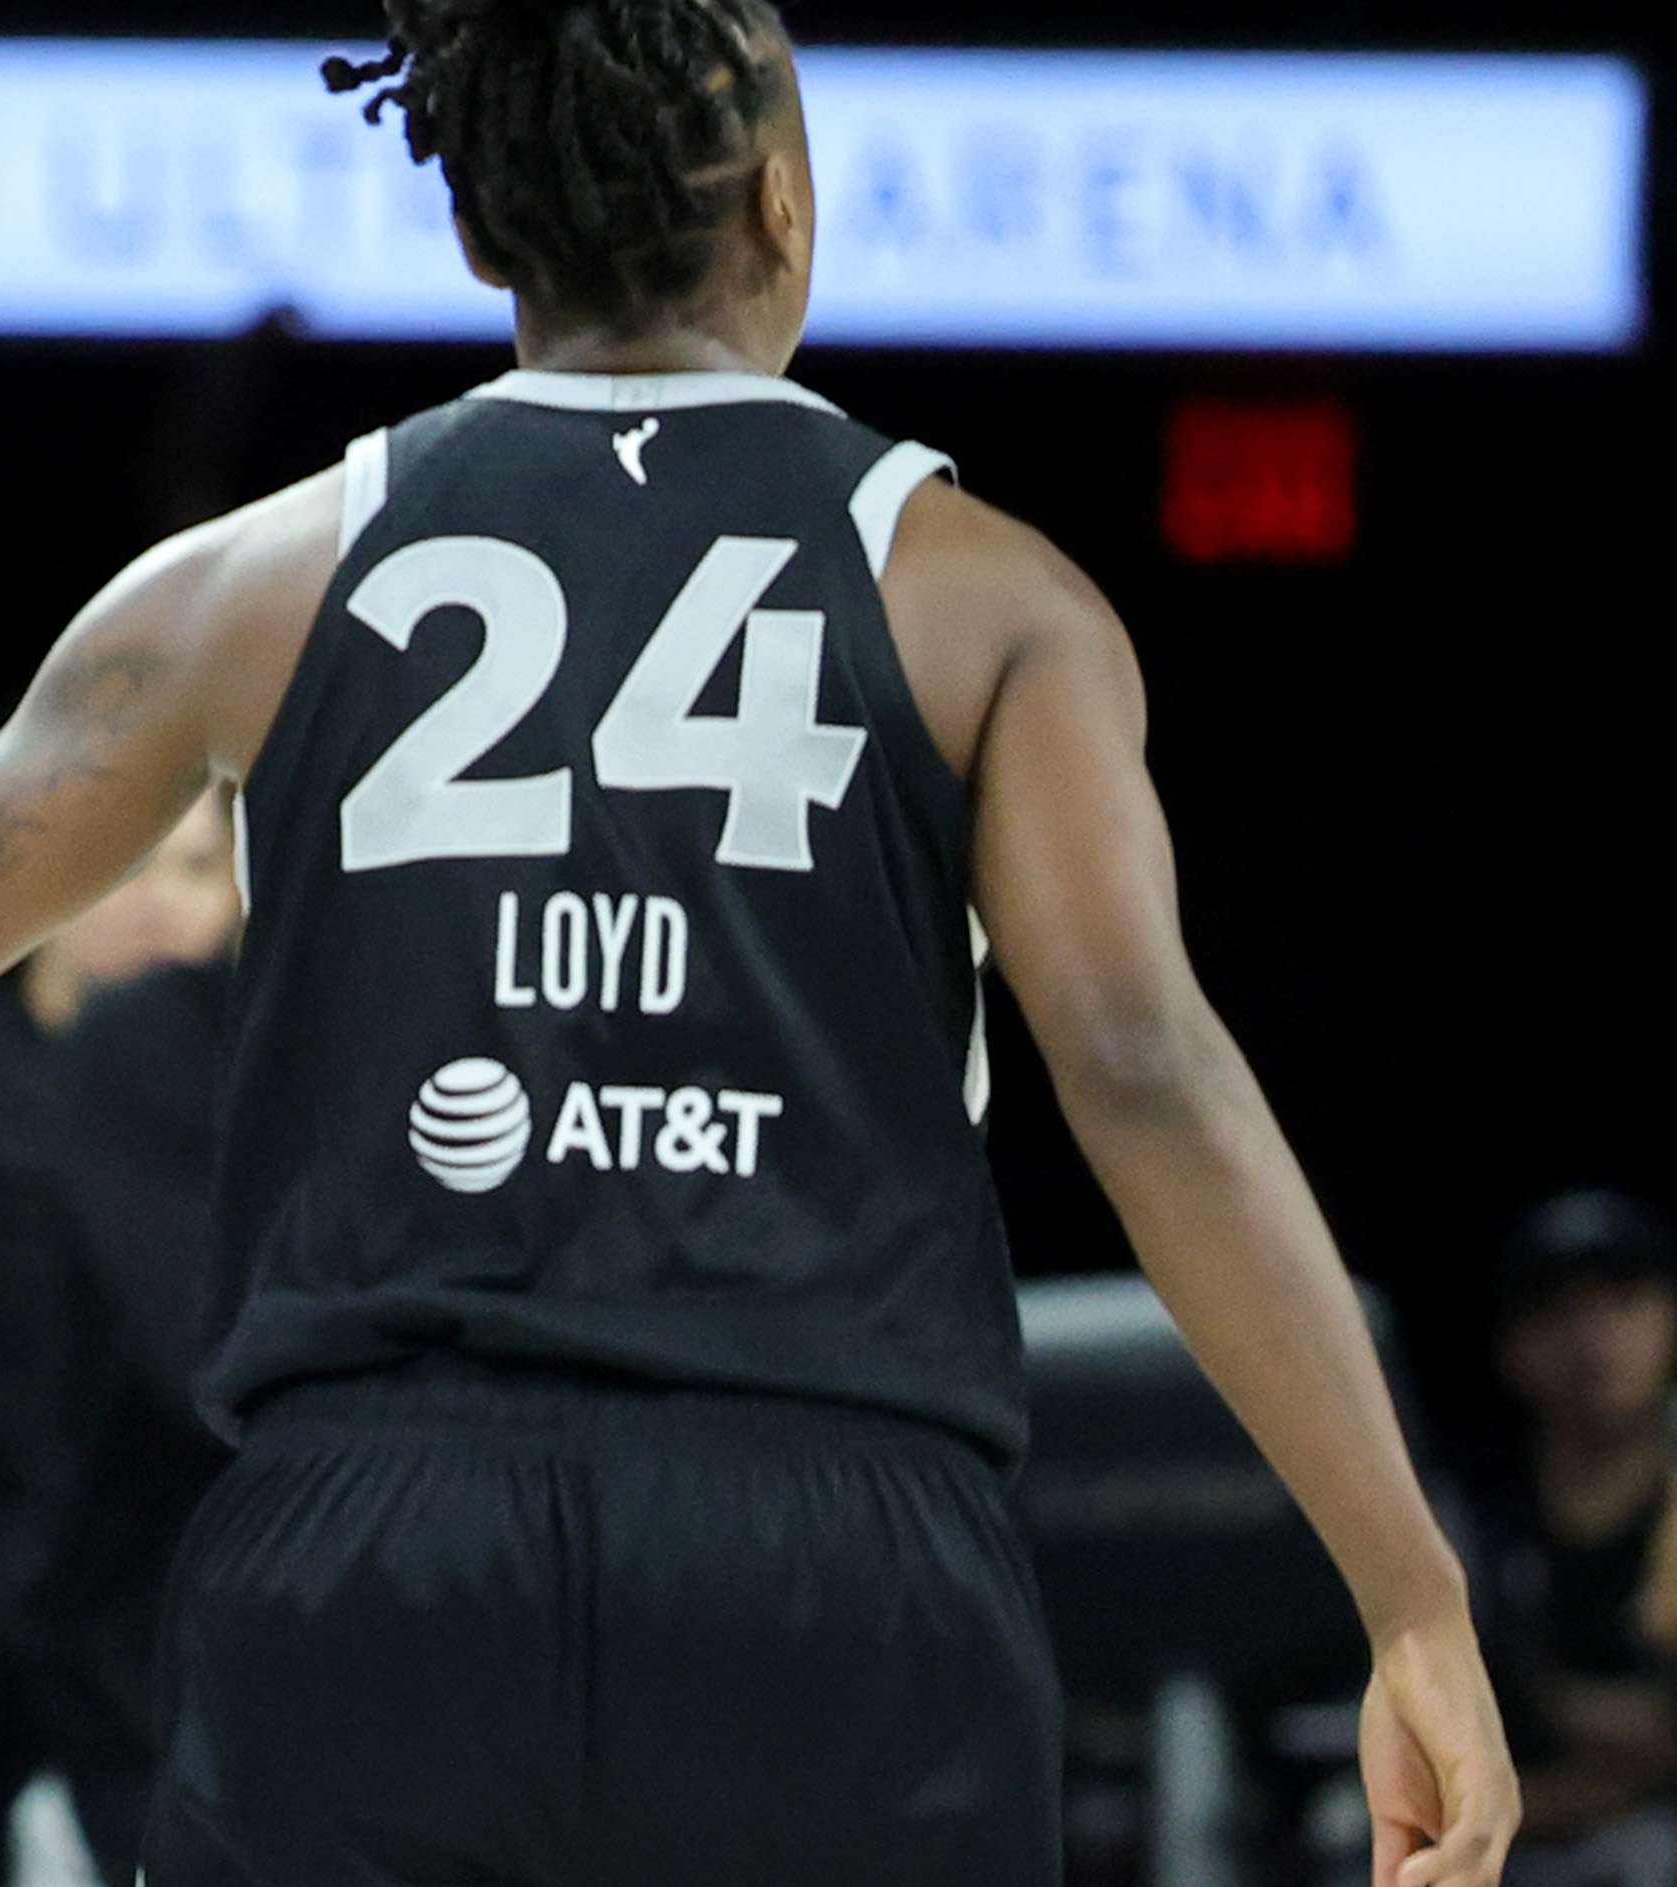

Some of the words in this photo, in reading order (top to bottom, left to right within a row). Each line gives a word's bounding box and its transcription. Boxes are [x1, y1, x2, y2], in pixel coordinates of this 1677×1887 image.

[42, 108, 454, 272] ULT
[834, 120, 1400, 280] ARENA
[340, 535, 869, 872] 24
[494, 890, 689, 1016] LOYD
[546, 1080, 784, 1178] AT&T
